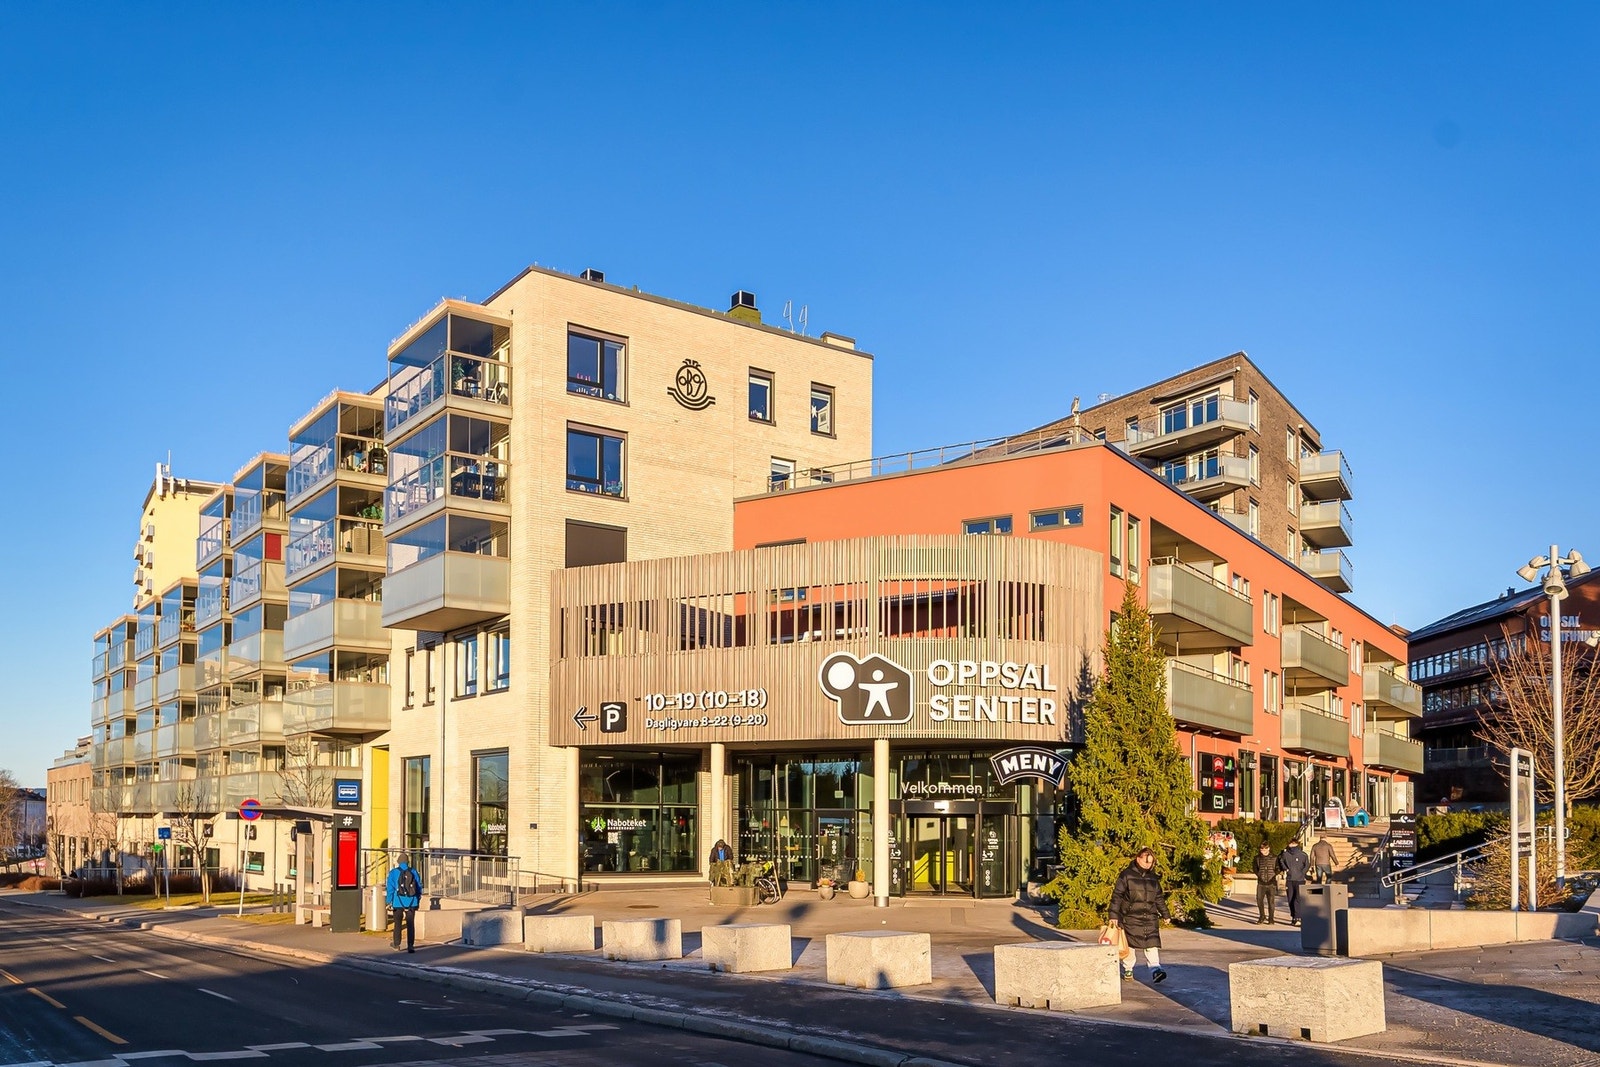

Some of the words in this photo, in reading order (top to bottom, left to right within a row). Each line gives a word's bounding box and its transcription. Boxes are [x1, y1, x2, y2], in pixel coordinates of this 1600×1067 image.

[1540, 615, 1581, 628] OSAL
[927, 659, 1057, 692] OPPSAL
[645, 693, 696, 711] 10-19
[700, 688, 767, 711] (10-18)
[928, 694, 1056, 725] SENTER
[606, 709, 620, 730] P
[646, 717, 699, 731] Dagligvare
[701, 715, 728, 727] 8-22
[730, 713, 768, 728] (9-20)
[1000, 754, 1062, 776] MENY
[901, 780, 983, 795] Velkommen
[607, 818, 647, 827] Naboteket
